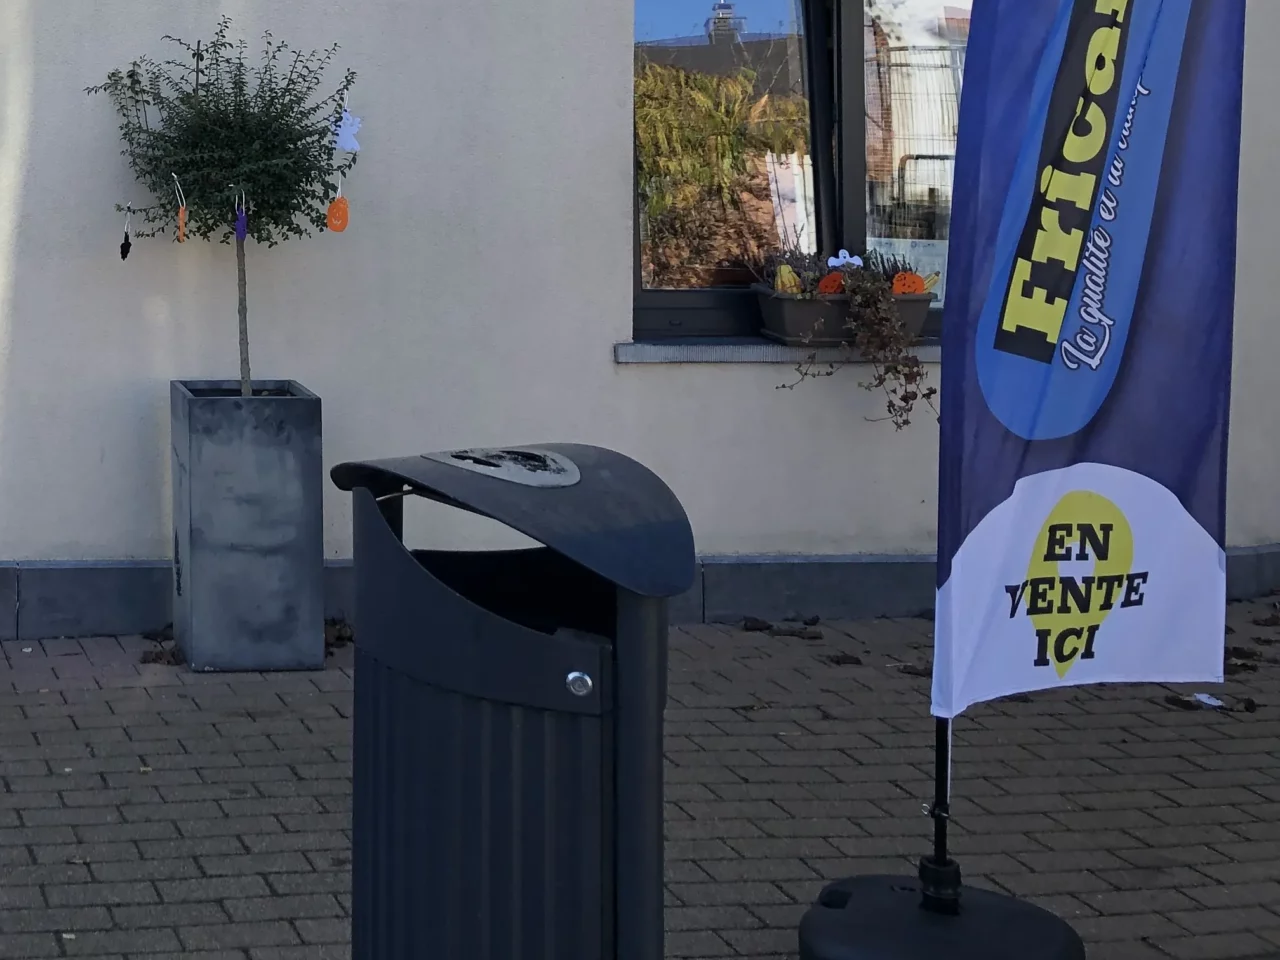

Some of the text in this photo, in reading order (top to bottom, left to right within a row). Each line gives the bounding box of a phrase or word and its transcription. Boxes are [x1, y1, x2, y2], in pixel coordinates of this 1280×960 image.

[1061, 324, 1110, 370] La
[1043, 523, 1114, 562] EN
[1004, 571, 1149, 619] VENTE
[1033, 624, 1100, 667] ICI
